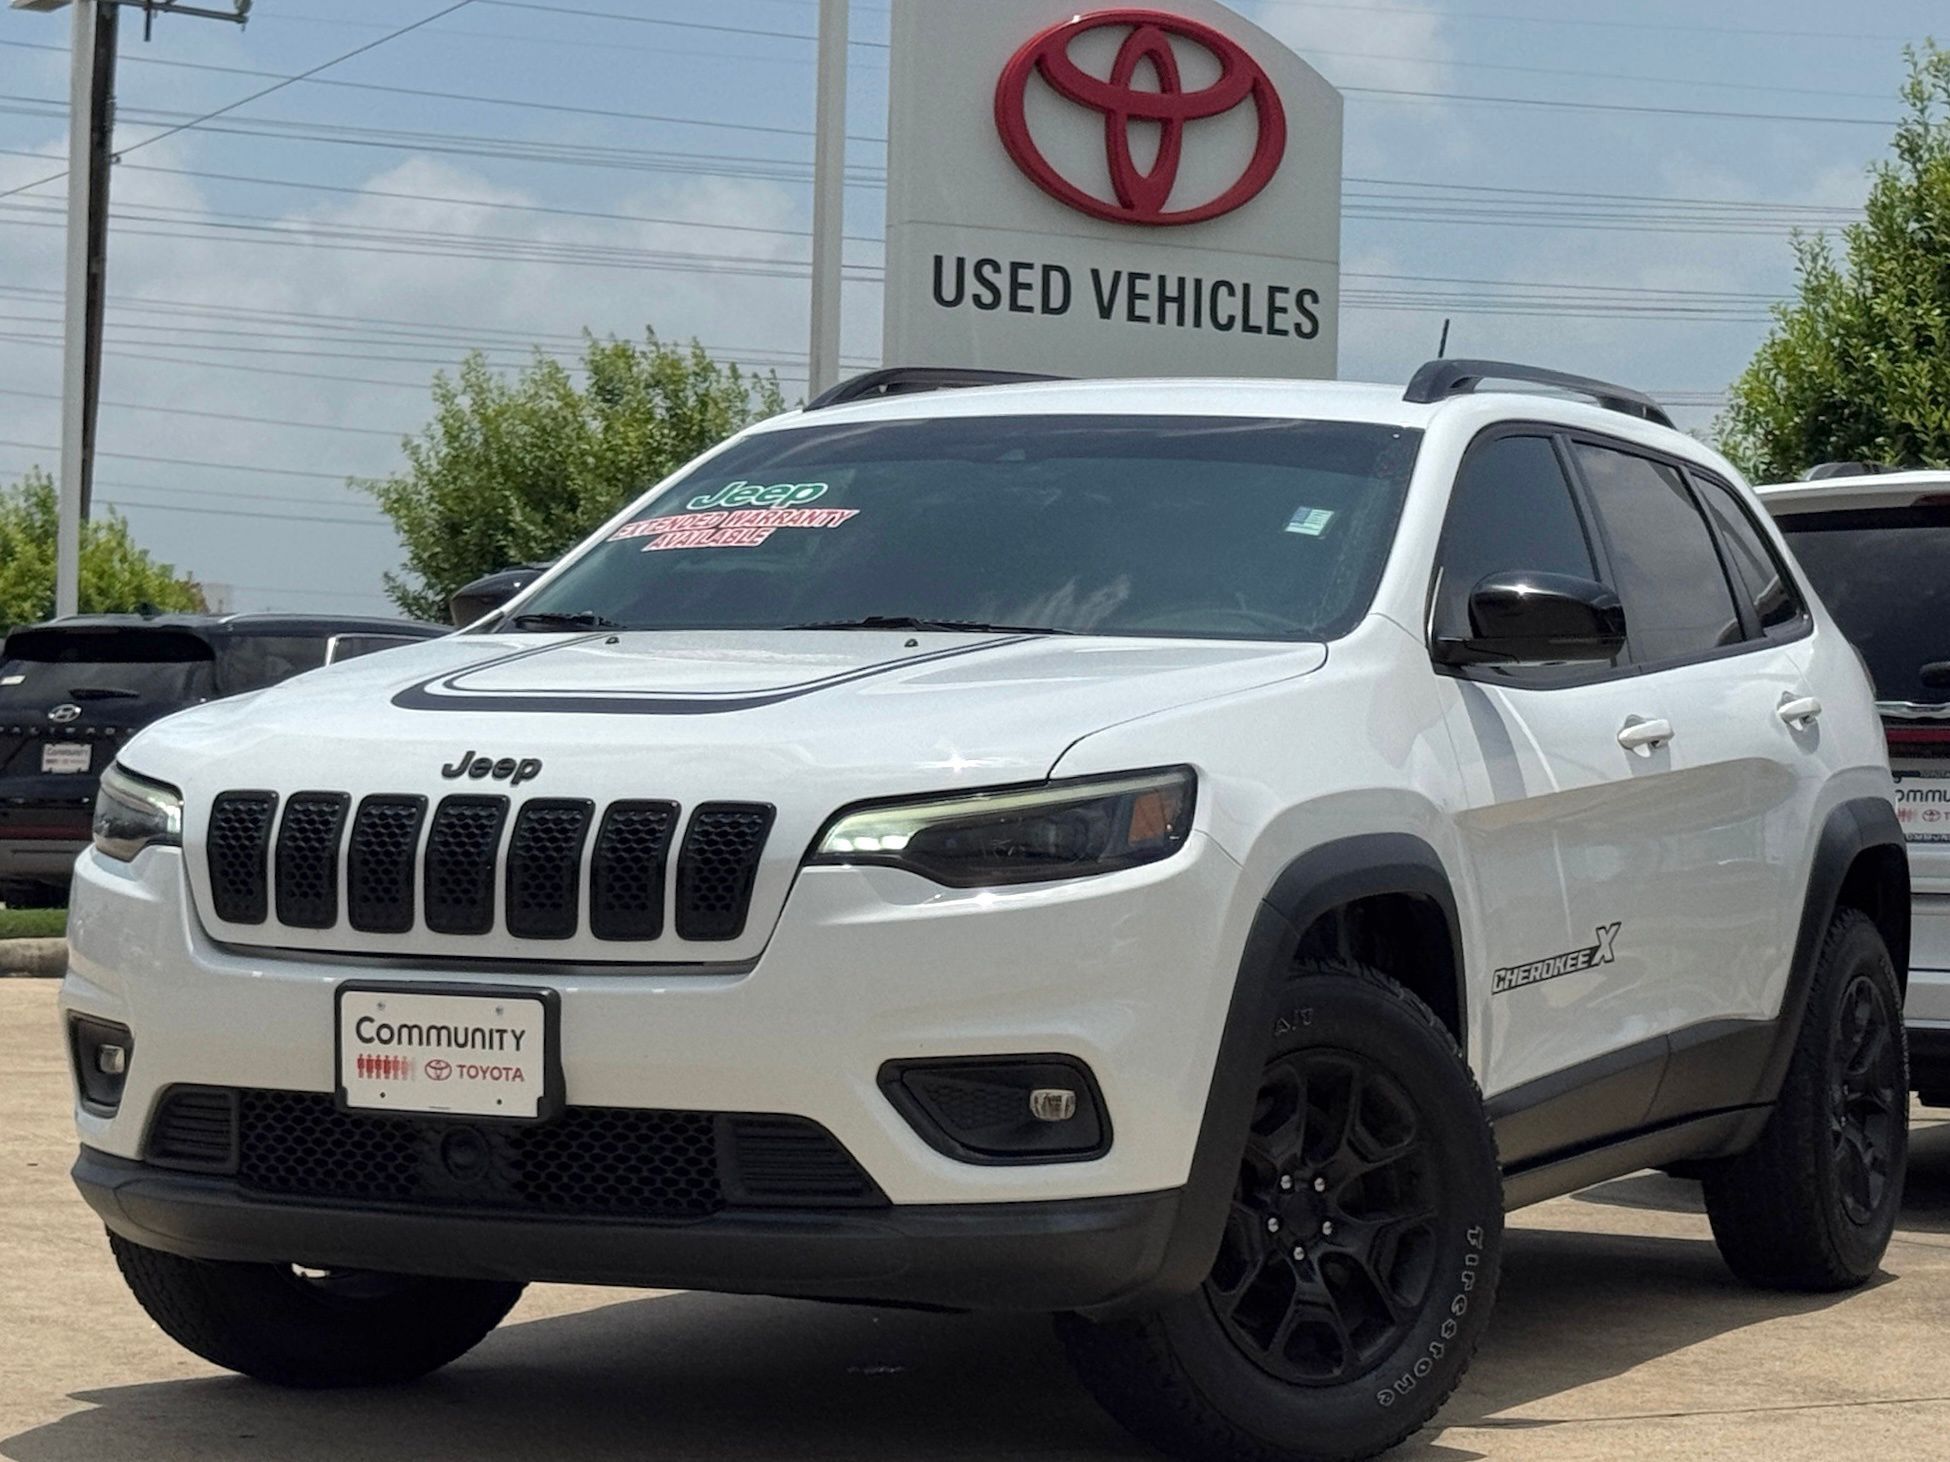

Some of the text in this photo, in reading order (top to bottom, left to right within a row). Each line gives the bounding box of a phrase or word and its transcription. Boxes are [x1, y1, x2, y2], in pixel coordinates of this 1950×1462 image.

[932, 254, 1321, 340] USED VEHICLES
[686, 480, 829, 509] Jeep
[614, 509, 856, 538] EXTENDED WARRANTY
[649, 529, 771, 549] AVAILABLE
[441, 750, 543, 786] Jeep
[1491, 921, 1622, 995] CHEROKEE X
[355, 1016, 526, 1051] Community
[456, 1064, 525, 1082] TOYOTA
